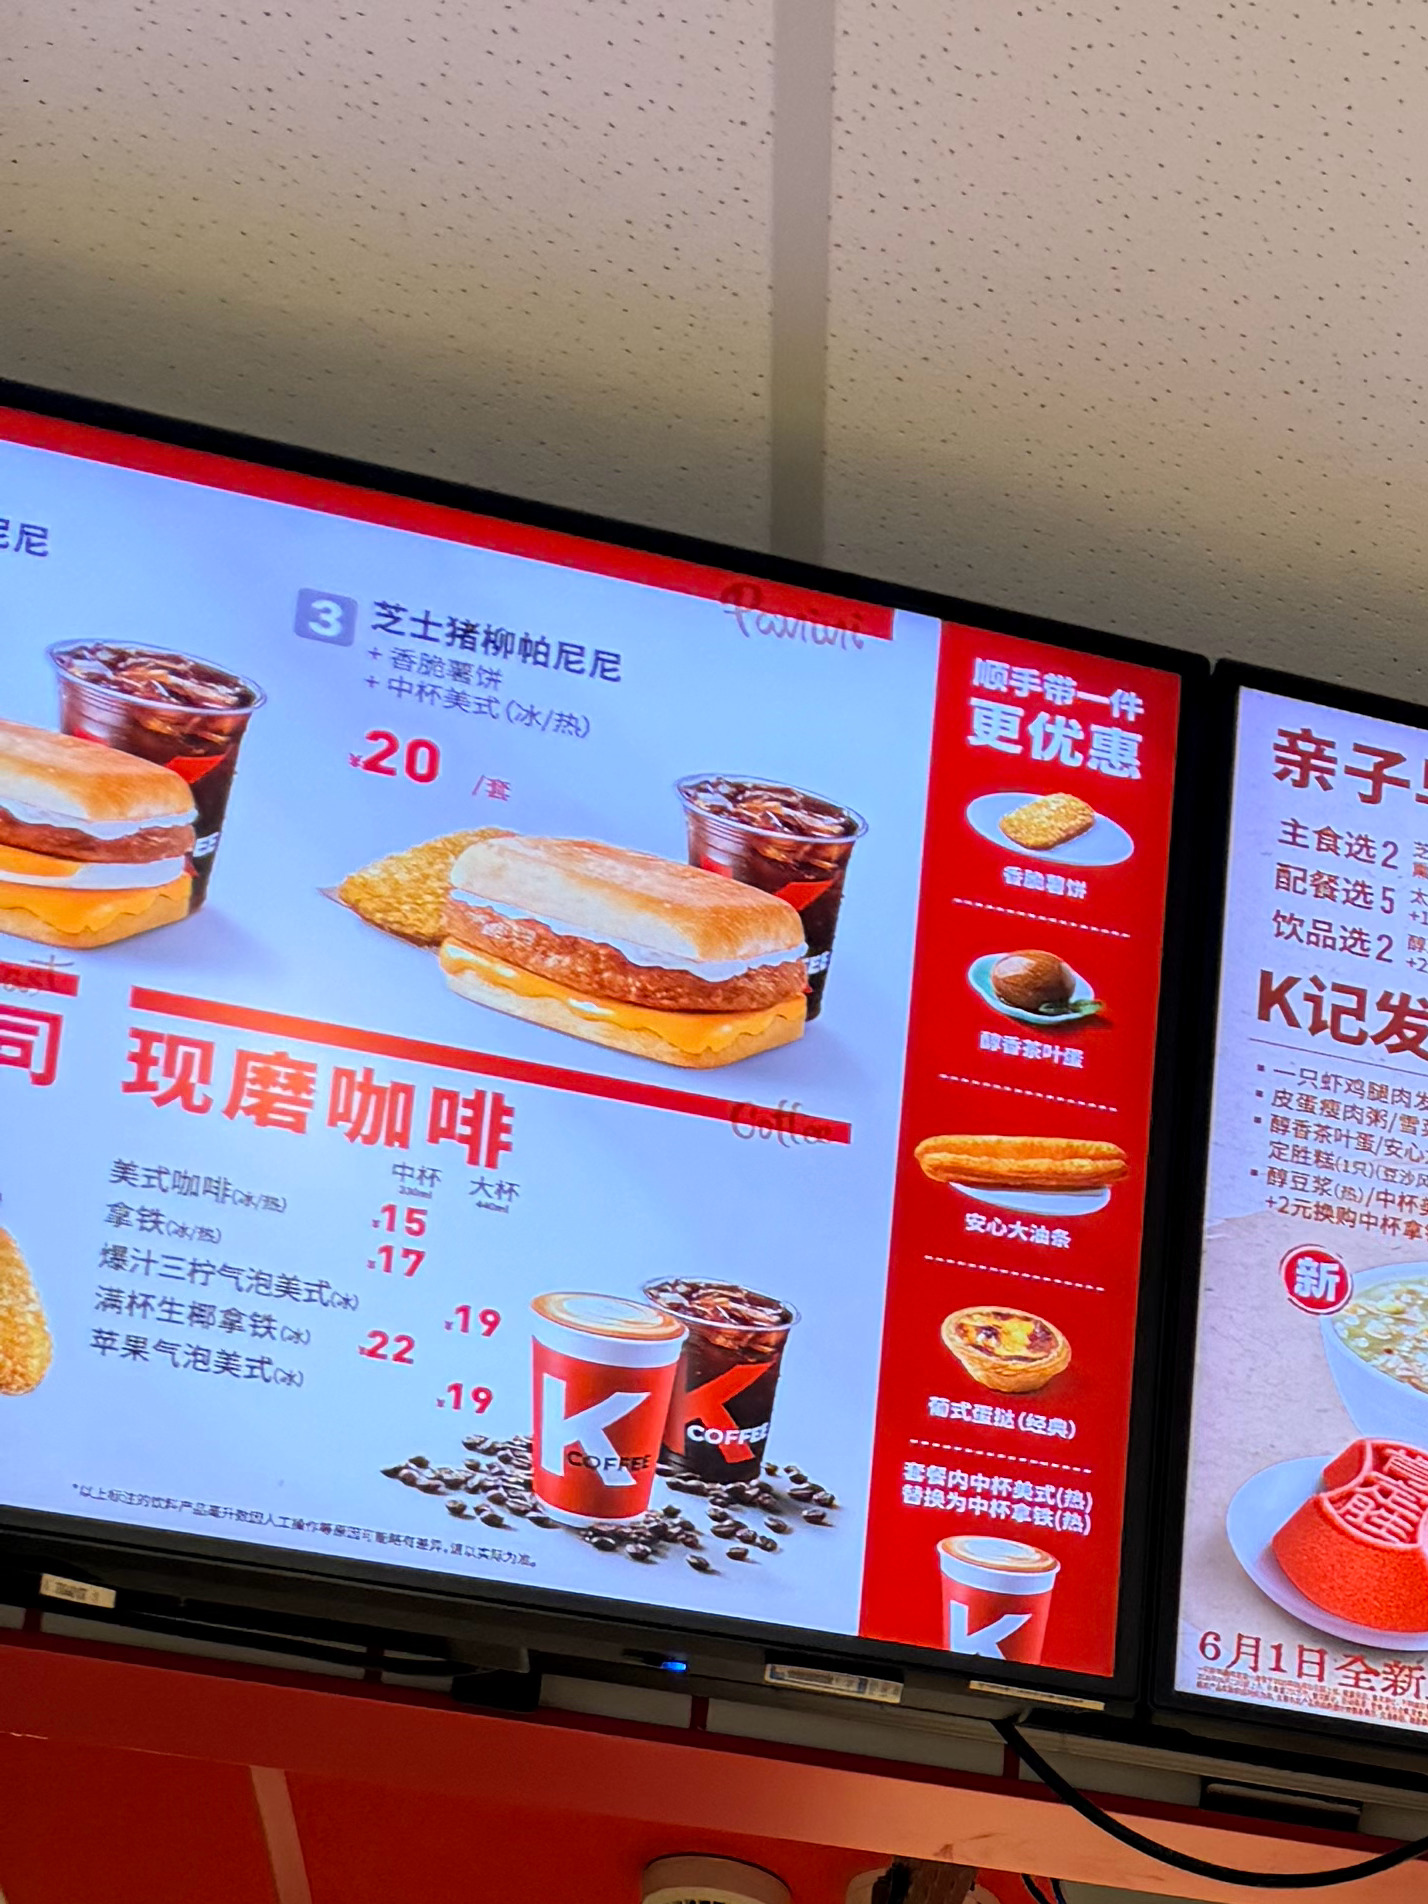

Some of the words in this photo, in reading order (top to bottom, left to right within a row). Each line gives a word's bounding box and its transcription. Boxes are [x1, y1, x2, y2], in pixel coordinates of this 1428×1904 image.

[0, 518, 49, 558] 尼
[307, 599, 344, 637] 3
[372, 600, 623, 682] 芝士猪柳帕尼尼
[972, 658, 1144, 723] 顺手带一件
[967, 696, 1144, 781] 更优惠
[1278, 817, 1400, 870] 主食选2
[1274, 862, 1396, 916] 配餐选5
[1272, 909, 1394, 963] 饮品选2
[0, 1006, 64, 1087] 司
[122, 1025, 515, 1170] 现磨咖啡
[729, 1098, 833, 1149] Coffee
[391, 1161, 443, 1189] 中杯
[469, 1177, 521, 1203] 大杯
[964, 1211, 1071, 1249] 安心大油条
[1294, 1257, 1340, 1303] 新
[686, 1422, 771, 1446] COFFEE
[567, 1449, 653, 1473] COFFEE
